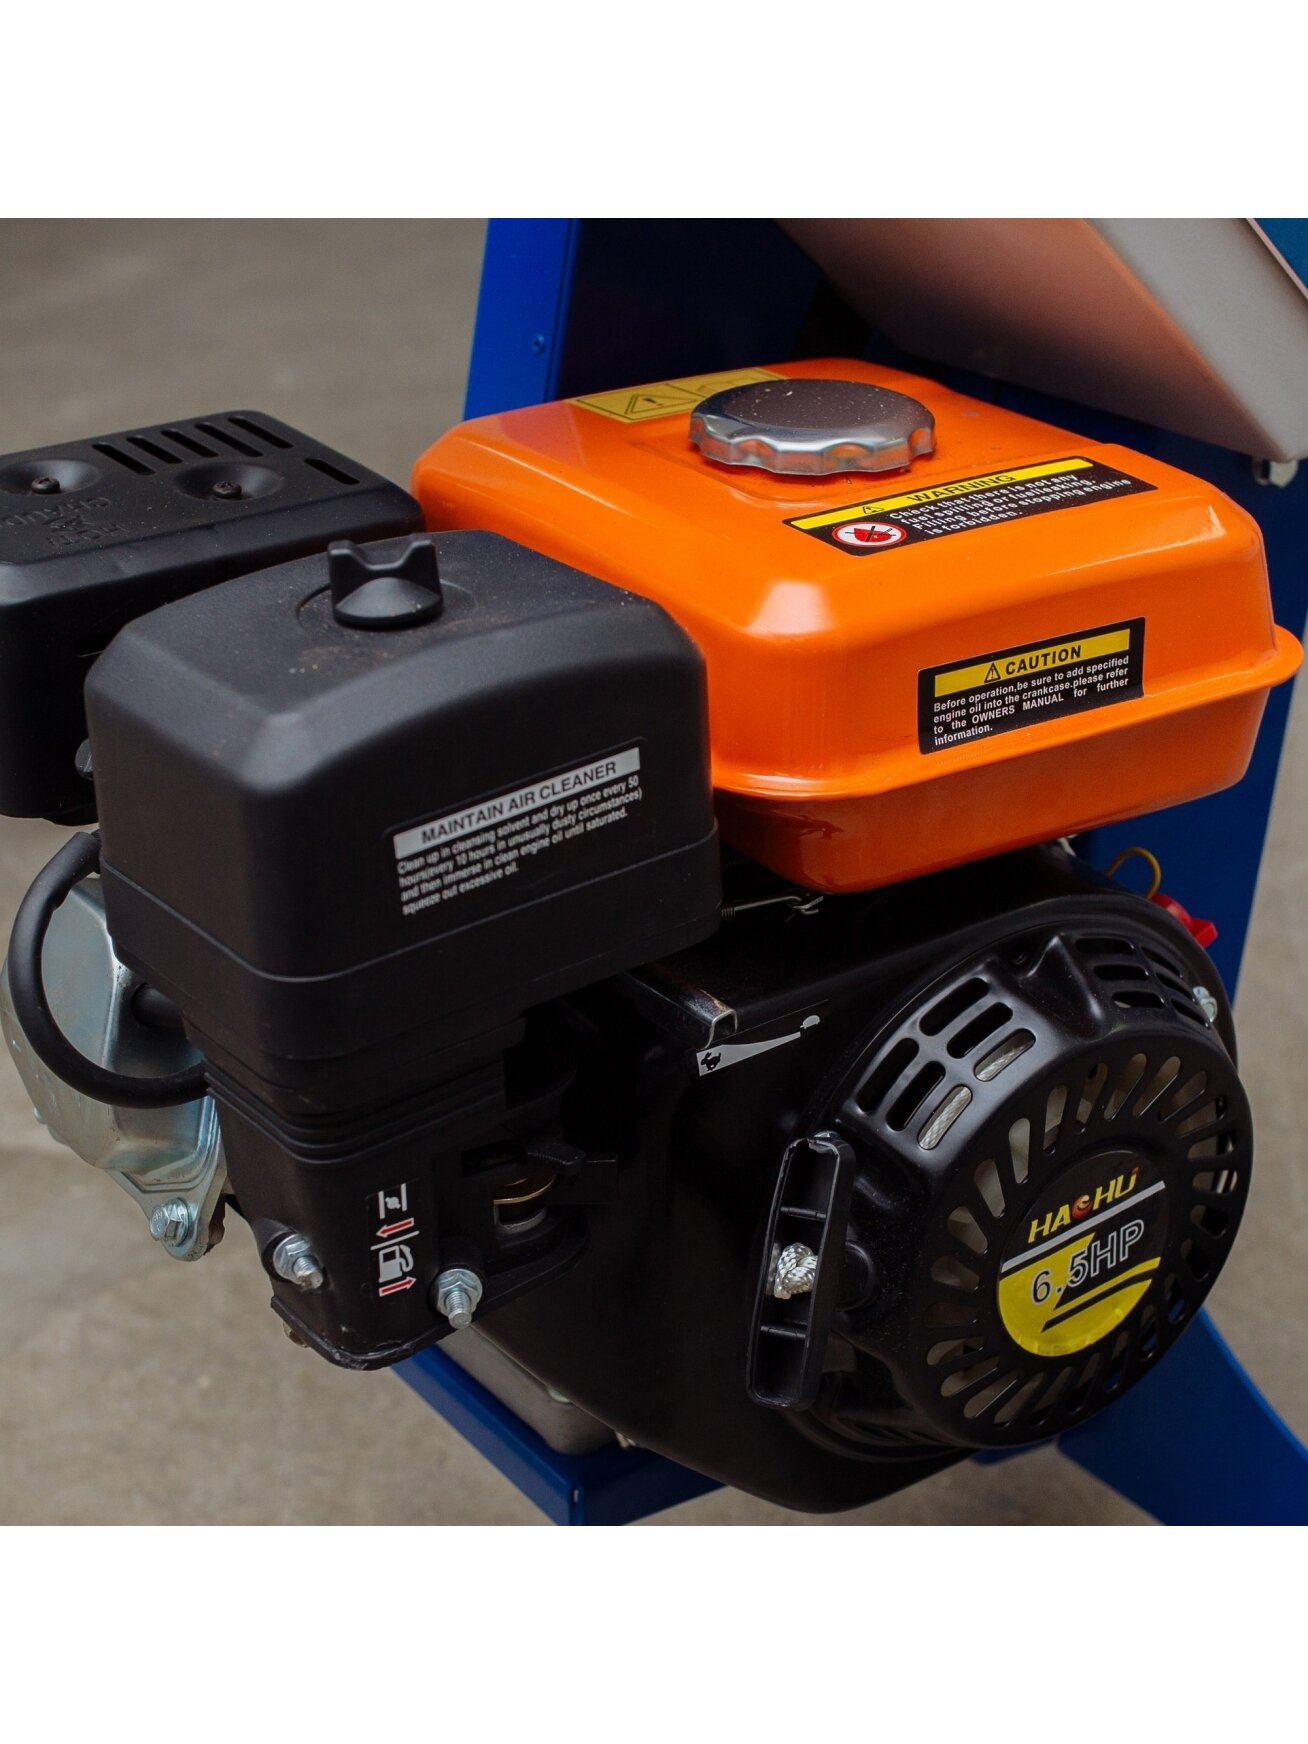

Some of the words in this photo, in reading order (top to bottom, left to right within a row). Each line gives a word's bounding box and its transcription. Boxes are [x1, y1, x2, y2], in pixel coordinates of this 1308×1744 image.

[889, 505, 939, 518] Check
[937, 497, 971, 507] that
[968, 489, 1010, 500] there
[1025, 479, 1052, 488] not
[1050, 474, 1078, 483] any
[900, 513, 934, 524] fuel
[934, 499, 994, 516] spilling
[906, 475, 1016, 501] WARNING
[912, 514, 967, 529] Filling
[966, 503, 1018, 517] before
[1018, 489, 1085, 505] stopping
[1083, 479, 1131, 492] engine
[941, 511, 1023, 530] forbidden.
[933, 697, 966, 712] Before
[968, 681, 1028, 703] operation,be
[1031, 675, 1051, 686] sure
[1054, 672, 1064, 681] to
[1066, 665, 1083, 678] add
[1086, 655, 1128, 673] specified
[1005, 645, 1081, 675] CAUTION
[933, 708, 966, 723] engine
[969, 702, 981, 713] oil
[984, 699, 1002, 709] into
[1004, 694, 1019, 704] the
[1106, 667, 1128, 679] refer
[933, 725, 943, 734] to
[951, 719, 966, 729] the
[971, 704, 1015, 723] OWNERS
[1022, 692, 1064, 710] MANUAL
[1073, 688, 1087, 697] for
[1096, 678, 1128, 692] further
[934, 724, 992, 745] information.
[397, 857, 425, 874] Clean
[426, 851, 439, 863] up
[440, 847, 451, 857] in
[451, 830, 496, 854] cleansing
[496, 816, 530, 837] solvent
[531, 808, 548, 824] and
[549, 804, 565, 817] dry
[566, 799, 578, 811] up
[579, 790, 601, 806] once
[602, 781, 626, 797] every
[628, 774, 639, 788] 50
[422, 802, 503, 843] MAINTAIN
[508, 791, 535, 811] AIR
[539, 761, 616, 799] CLEANER
[455, 852, 467, 865] 10
[468, 844, 495, 861] hours
[496, 840, 506, 854] in
[507, 823, 550, 846] unusually
[551, 809, 576, 830] dusty
[578, 787, 642, 820] circumstances)
[401, 886, 419, 901] and
[420, 878, 442, 893] then
[442, 862, 482, 884] immerse
[483, 858, 493, 869] in
[494, 849, 519, 865] clean
[519, 837, 550, 855] engine
[551, 829, 563, 843] oil
[564, 821, 584, 838] until
[585, 806, 627, 830] saturated.
[402, 892, 440, 915] squeeze
[441, 884, 457, 899] out
[458, 868, 503, 892] excessive
[504, 861, 518, 875] oil.
[1031, 1219, 1145, 1305] 6.5HP
